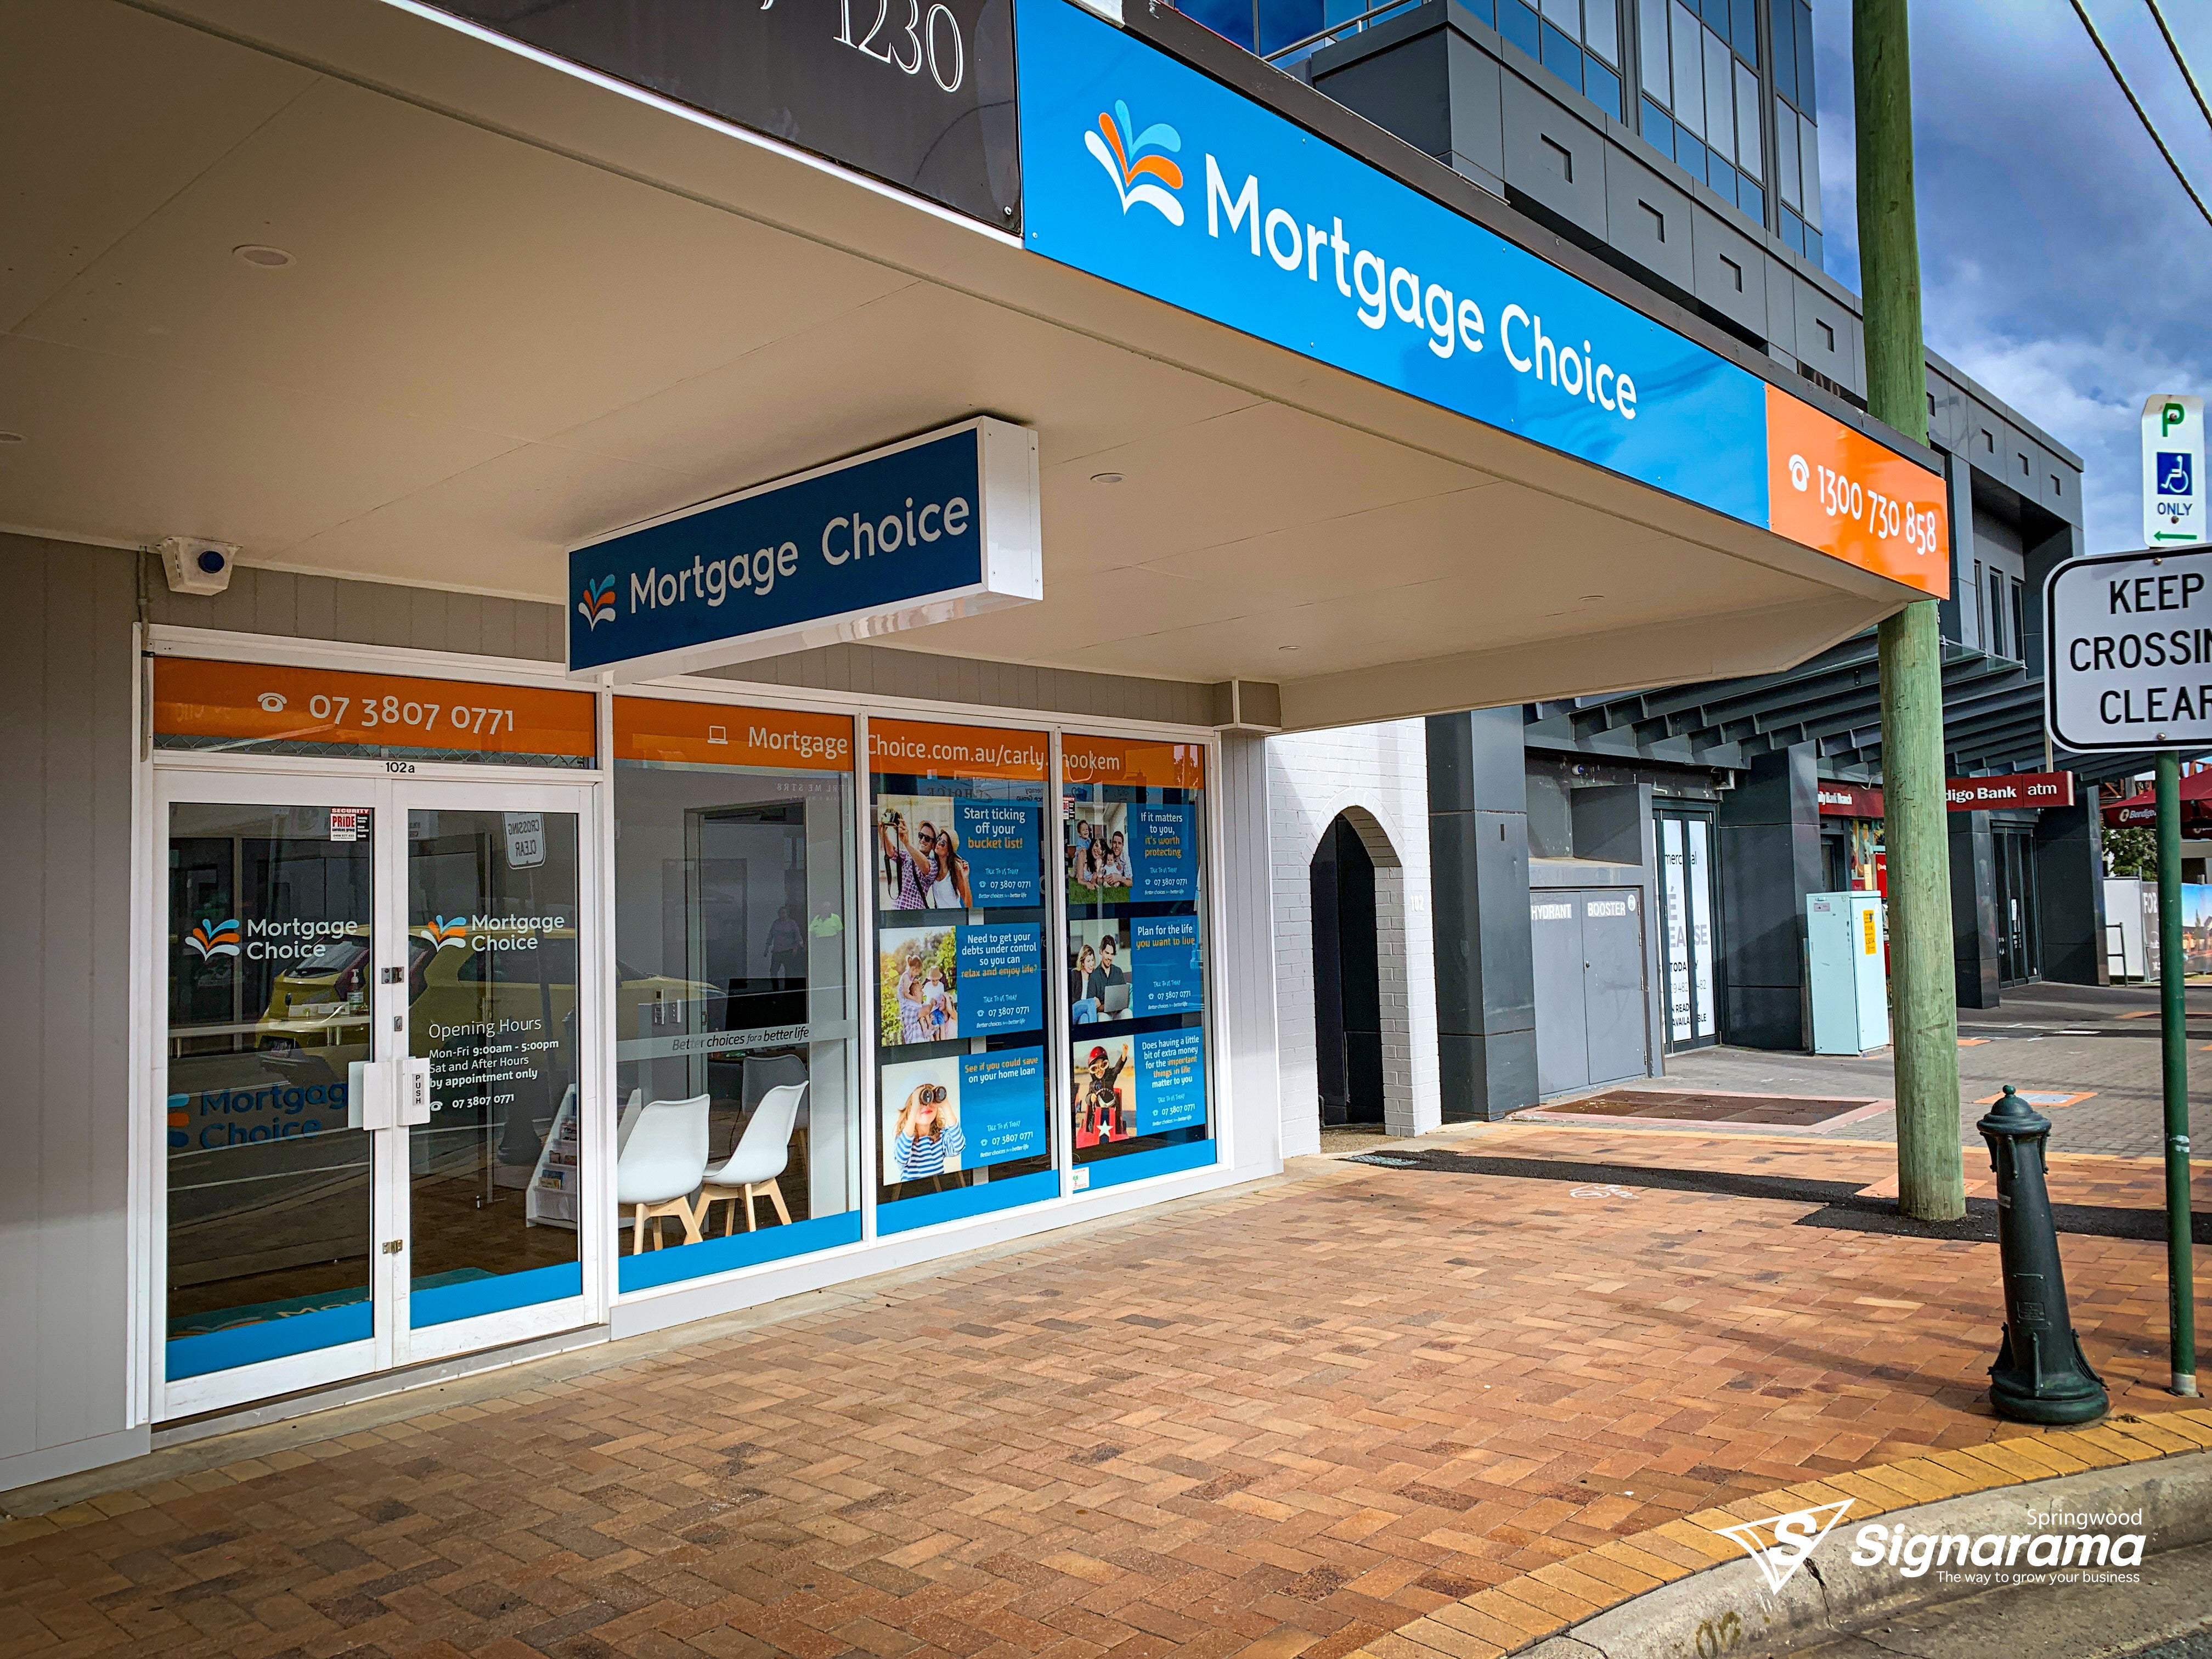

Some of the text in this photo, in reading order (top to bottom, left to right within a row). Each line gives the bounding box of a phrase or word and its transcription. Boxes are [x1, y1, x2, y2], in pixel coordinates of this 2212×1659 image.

[833, 0, 963, 92] 1230
[1205, 153, 1638, 420] Mortgage Choice
[2163, 403, 2185, 437] P
[1818, 465, 1936, 555] 1300 730 858
[2158, 503, 2193, 516] ONLY
[630, 496, 970, 614] Mortgage Choice
[2109, 573, 2204, 614] KEEP
[309, 695, 514, 734] 07 3807 0771
[749, 727, 849, 759] Mortgage
[386, 761, 415, 774] 102a
[1977, 786, 2017, 799] Bank
[2028, 783, 2057, 795] atm
[964, 807, 1025, 824] Start ticking
[1141, 812, 1182, 822] If it matters
[975, 822, 1015, 838] off your
[1150, 825, 1175, 836] to you,
[968, 837, 1023, 849] bucket list!
[1145, 835, 1180, 845] it's worth
[1145, 848, 1181, 859] protecting
[990, 880, 1031, 889] 07 3807 0771
[1410, 895, 1425, 912] 102
[1531, 901, 1626, 920] HYDRANT BOOSTER
[247, 918, 358, 940] Mortgage
[472, 914, 565, 934] Mortgage
[1138, 924, 1193, 935] Plan for the life
[472, 934, 539, 952] Choice
[968, 933, 1030, 944] Need to get your
[1136, 936, 1195, 950] you want to live
[247, 941, 326, 960] Choice
[962, 942, 1037, 955] debts under control
[991, 957, 1005, 968] you
[1006, 955, 1020, 964] can
[961, 968, 980, 978] relax
[983, 966, 997, 977] and
[999, 966, 1020, 978] enjoy
[1165, 991, 1178, 1000] 3807
[1180, 990, 1191, 998] 0771
[988, 1006, 1029, 1018] 07 3807 0771
[428, 1018, 541, 1041] Opening Hours
[673, 1038, 705, 1051] Better
[707, 1033, 744, 1047] choices
[747, 1034, 757, 1044] for
[764, 1029, 793, 1042] better
[794, 1027, 809, 1042] life
[1142, 1041, 1157, 1050] Does
[1159, 1039, 1180, 1048] having
[1185, 1036, 1199, 1045] little
[429, 1040, 559, 1059] Mon-Fri 9:00am 5:00pm
[1144, 1046, 1198, 1060] bit of extra money
[430, 1057, 529, 1074] Sat and After Hours
[964, 1062, 978, 1073] See
[979, 1060, 985, 1071] if
[986, 1059, 1000, 1073] you
[1001, 1057, 1021, 1069] could
[1146, 1055, 1197, 1069] for the important
[430, 1068, 538, 1090] by appointment only
[968, 1066, 1035, 1084] on your home loan
[1153, 1069, 1172, 1079] things
[1181, 1065, 1191, 1074] life
[1152, 1079, 1172, 1088] matter
[1181, 1075, 1193, 1086] you
[201, 1082, 348, 1116] Mortgag
[452, 1093, 515, 1109] 07 3807 0771
[1170, 1105, 1183, 1115] 3807
[1184, 1103, 1195, 1111] 0771
[201, 1118, 322, 1150] Choice
[992, 1131, 1034, 1146] 07 3807 0771
